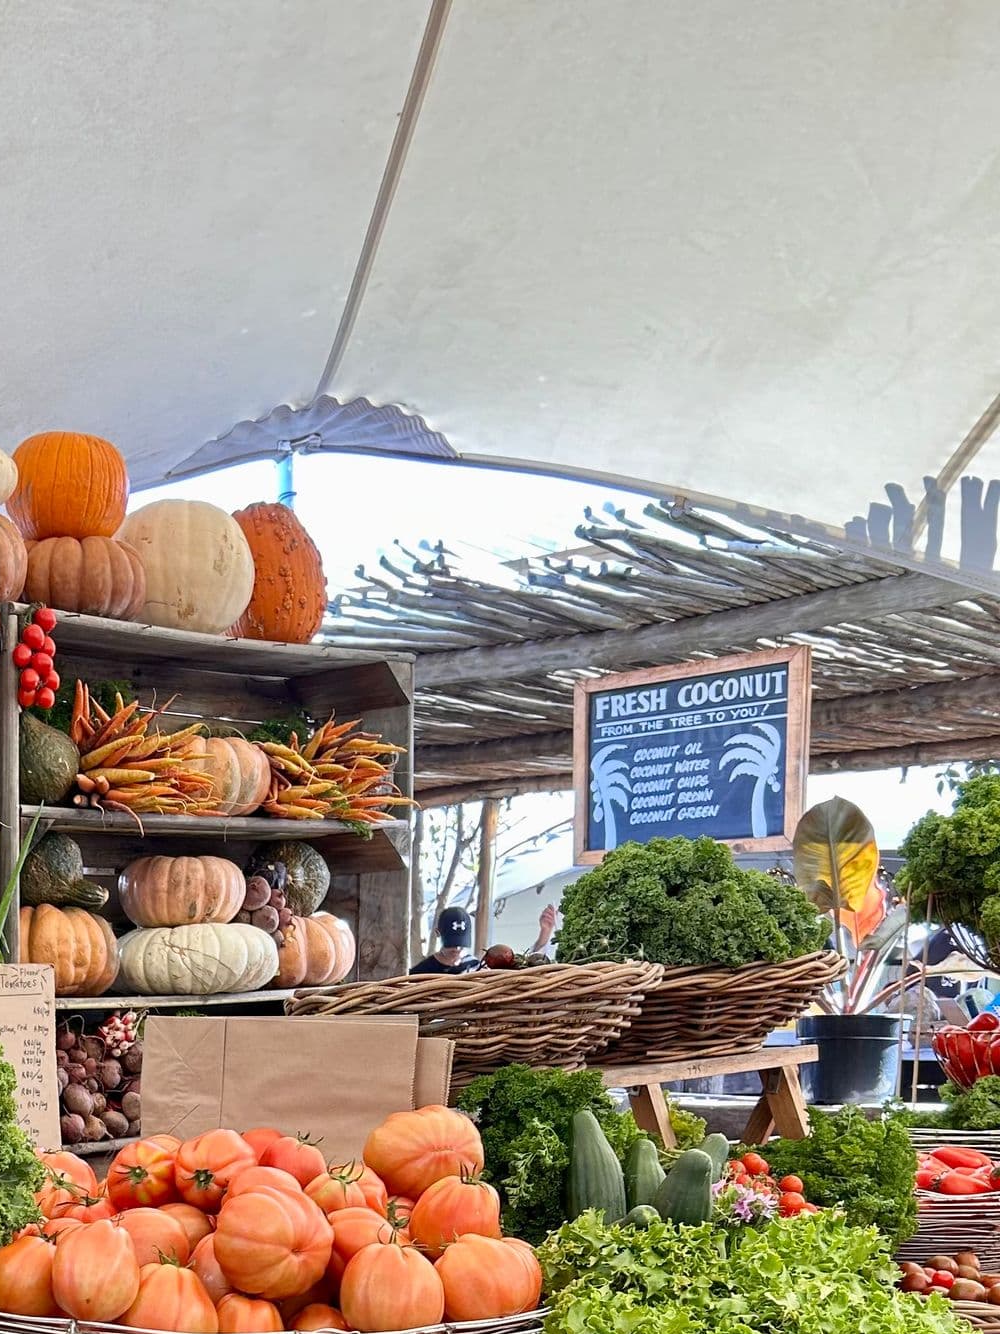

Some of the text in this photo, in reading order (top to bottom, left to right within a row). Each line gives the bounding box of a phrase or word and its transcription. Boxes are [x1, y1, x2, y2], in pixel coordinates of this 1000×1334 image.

[596, 670, 787, 720] FRESH COCONUT
[601, 725, 633, 737] FROM
[639, 720, 663, 731] THE
[670, 714, 702, 727] TREE
[706, 710, 726, 722] TO
[633, 742, 703, 763] COCONUT OIL
[630, 758, 710, 779] COCONUT WATER
[632, 774, 709, 795] COCONUT CHIPS
[631, 787, 714, 809] COCONUT BROWN
[630, 804, 721, 825] COCONUT GREEN
